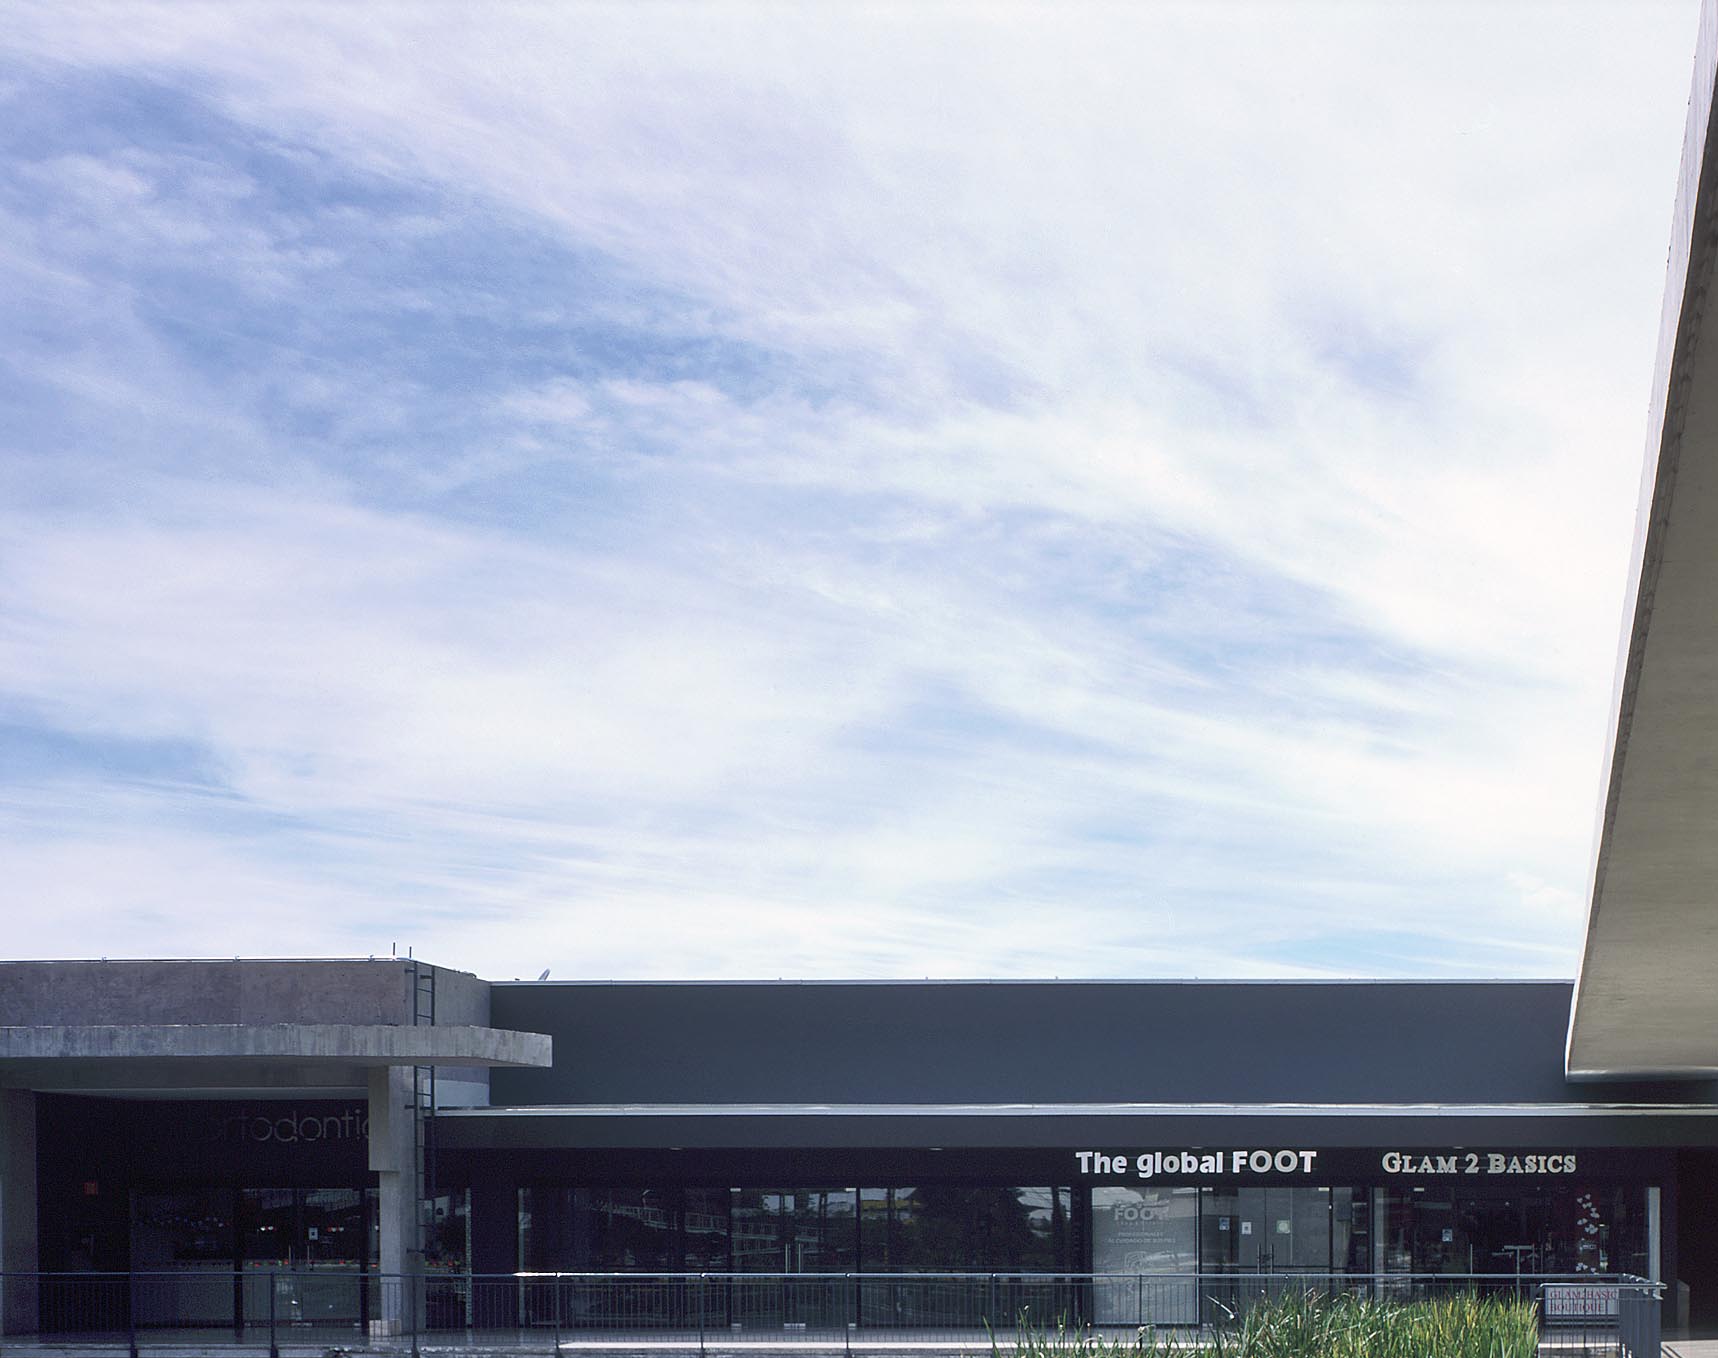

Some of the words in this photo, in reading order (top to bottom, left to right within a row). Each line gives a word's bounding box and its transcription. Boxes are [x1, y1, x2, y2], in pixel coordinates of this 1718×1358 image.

[1075, 1151, 1128, 1174] The
[1136, 1151, 1224, 1178] global
[1232, 1150, 1317, 1174] FOOT
[1381, 1152, 1458, 1174] GLAM
[1464, 1153, 1480, 1174] 2
[1487, 1153, 1577, 1174] BASICS
